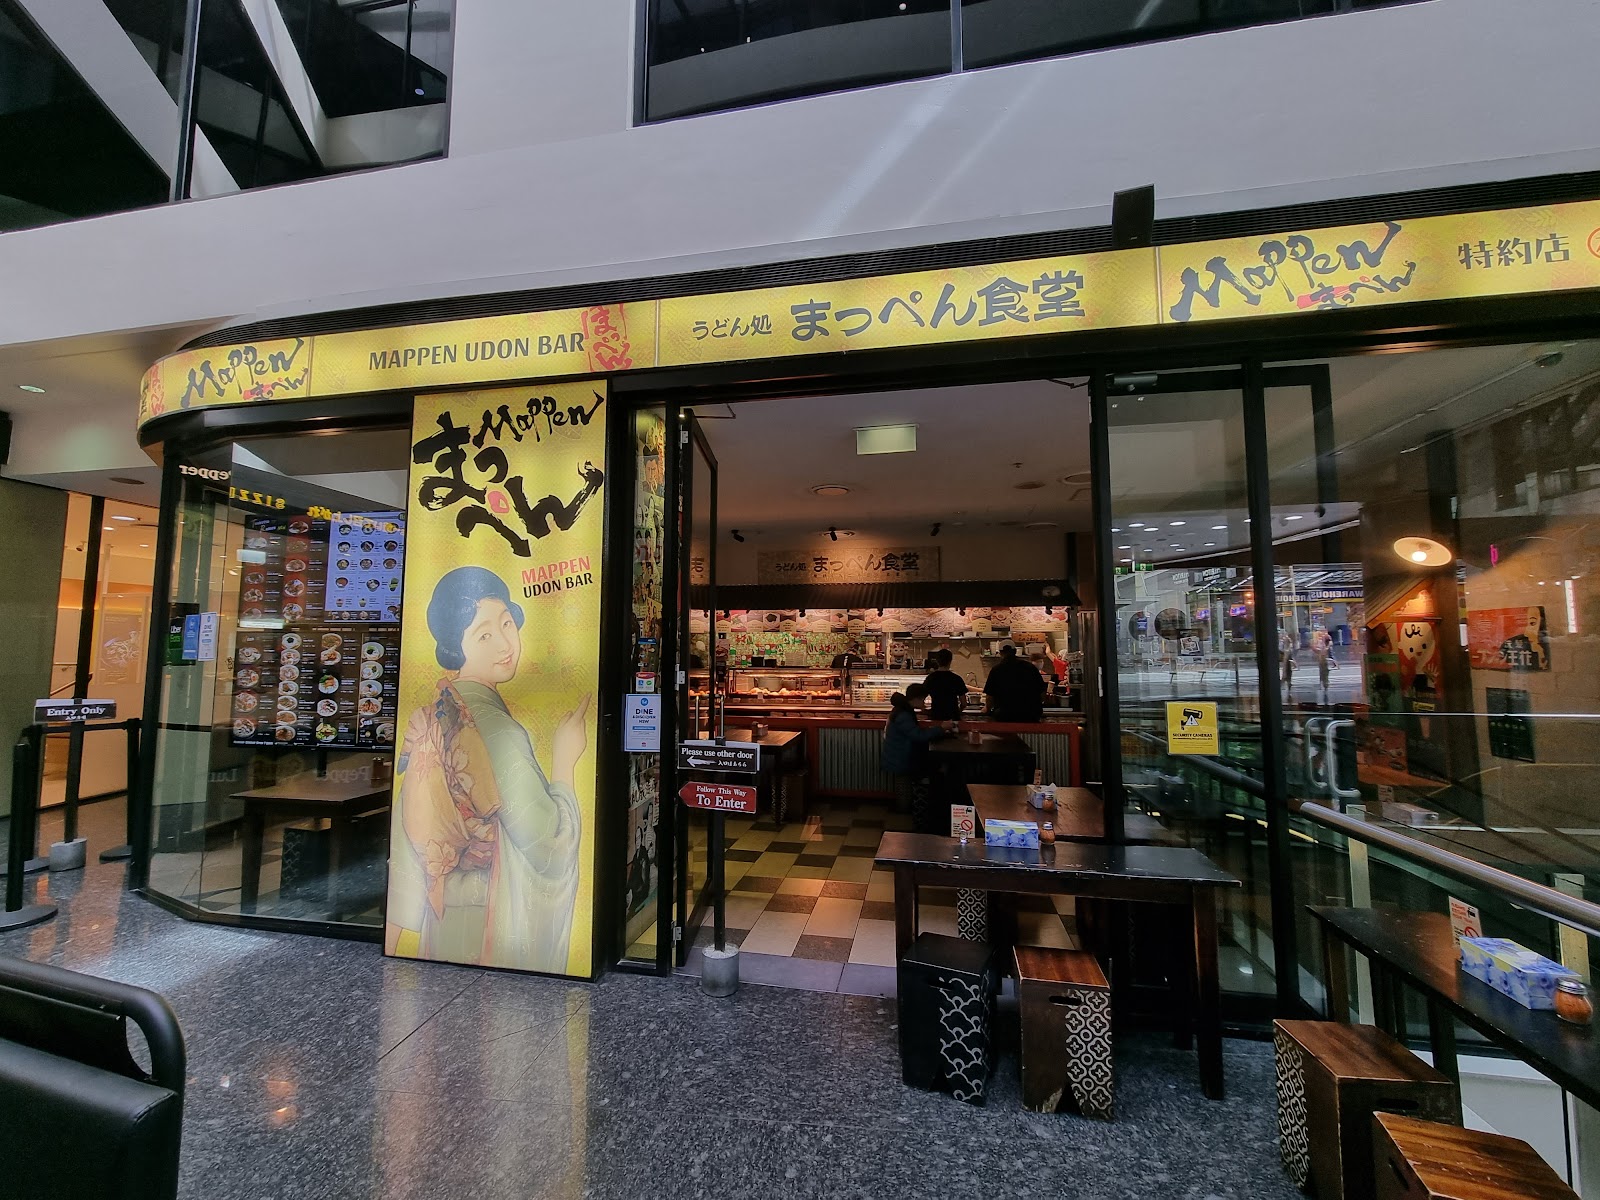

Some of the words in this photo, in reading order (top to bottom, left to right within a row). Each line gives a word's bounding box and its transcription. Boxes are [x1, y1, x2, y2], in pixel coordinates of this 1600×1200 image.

[1458, 233, 1569, 270] 特約店
[1169, 221, 1402, 322] Mappen
[692, 313, 772, 341] うどん処
[790, 270, 1086, 342] まっぺん食堂
[369, 344, 457, 370] MAPPEN
[465, 337, 529, 362] UDON
[538, 332, 585, 355] BAR
[180, 337, 305, 409] Mappen
[472, 389, 605, 449] Mappen
[521, 555, 591, 585] MAPPEN
[813, 553, 919, 573] まっぺん食堂
[523, 580, 562, 599] UDON
[565, 572, 594, 590] BAR
[46, 708, 78, 717] Entry
[81, 706, 106, 715] Only
[681, 747, 703, 756] Please
[717, 750, 736, 758] other
[737, 751, 754, 760] door
[696, 785, 717, 793] Follow
[717, 787, 732, 795] This
[733, 788, 748, 798] Way
[696, 793, 711, 806] To
[715, 795, 747, 810] Enter
